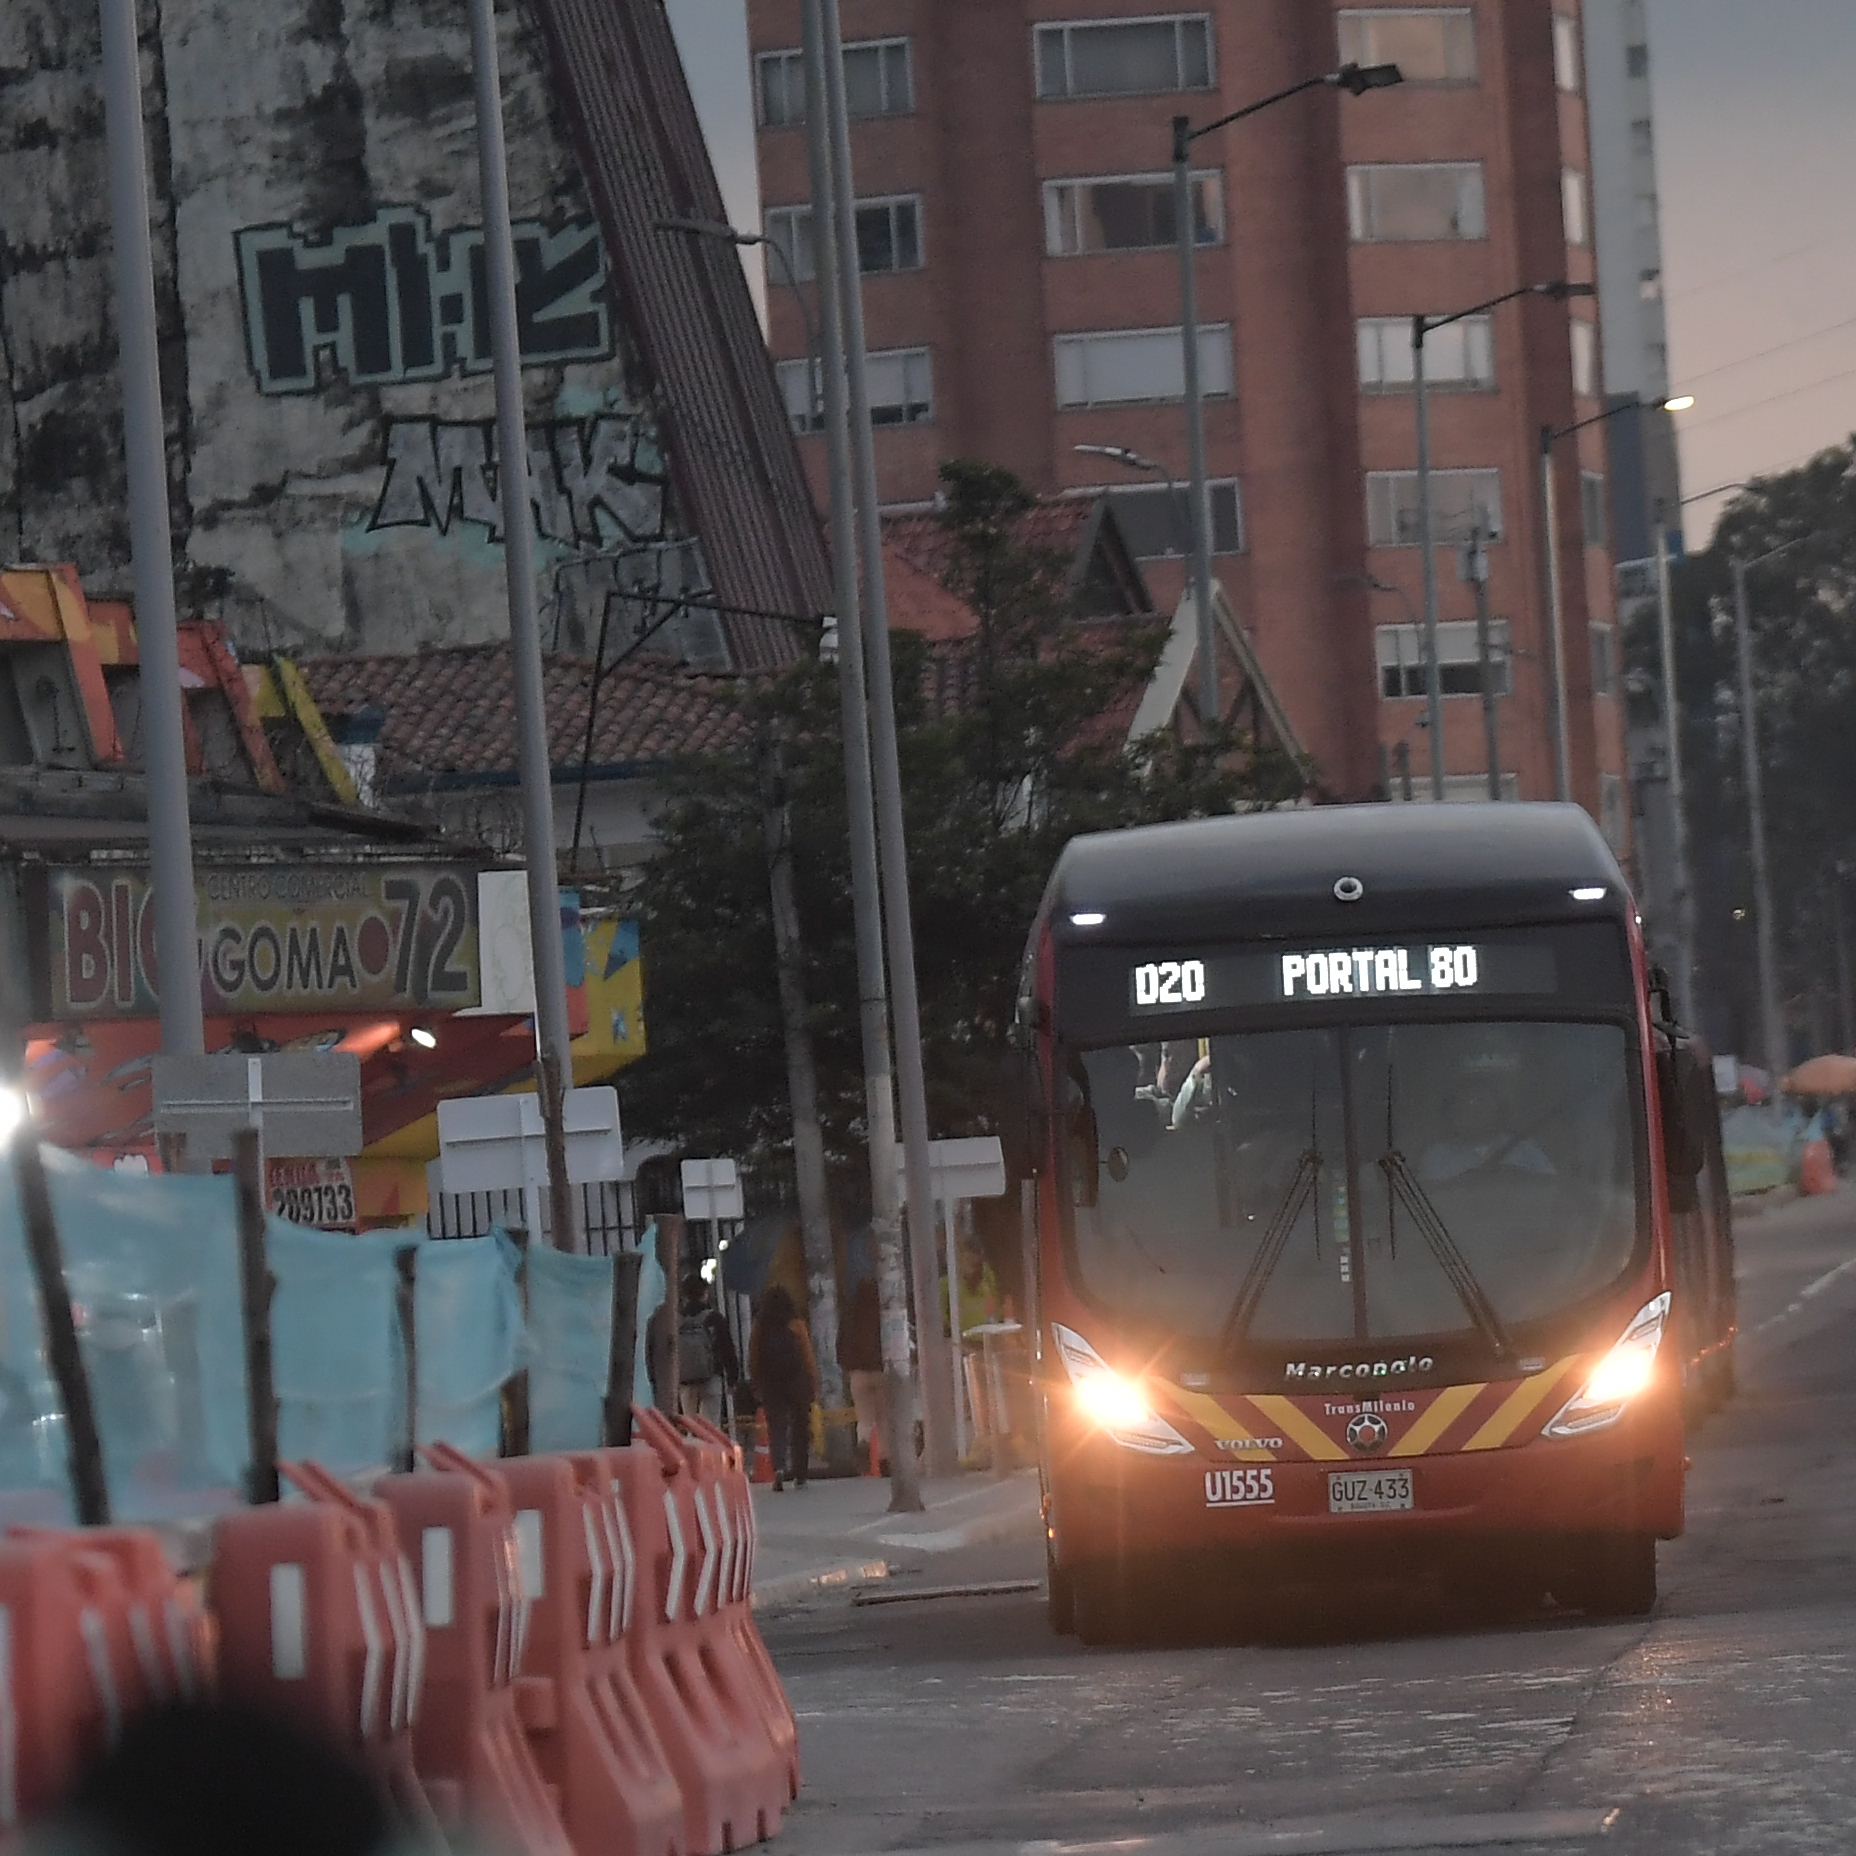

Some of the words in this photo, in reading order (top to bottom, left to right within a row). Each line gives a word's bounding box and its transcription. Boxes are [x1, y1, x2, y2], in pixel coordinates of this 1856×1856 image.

[207, 872, 270, 900] CENTRO
[273, 871, 369, 899] COMERCIAL
[64, 879, 161, 1007] BI
[197, 916, 358, 996] GOMA
[380, 874, 475, 1001] 72
[1136, 960, 1206, 1004] D20
[1282, 948, 1421, 996] PORTAL
[1430, 945, 1479, 988] 80
[1285, 1355, 1434, 1381] Marcopolo
[1324, 1399, 1416, 1416] TransMilenio
[1214, 1437, 1284, 1451] VOLVO
[1205, 1468, 1275, 1502] U1555
